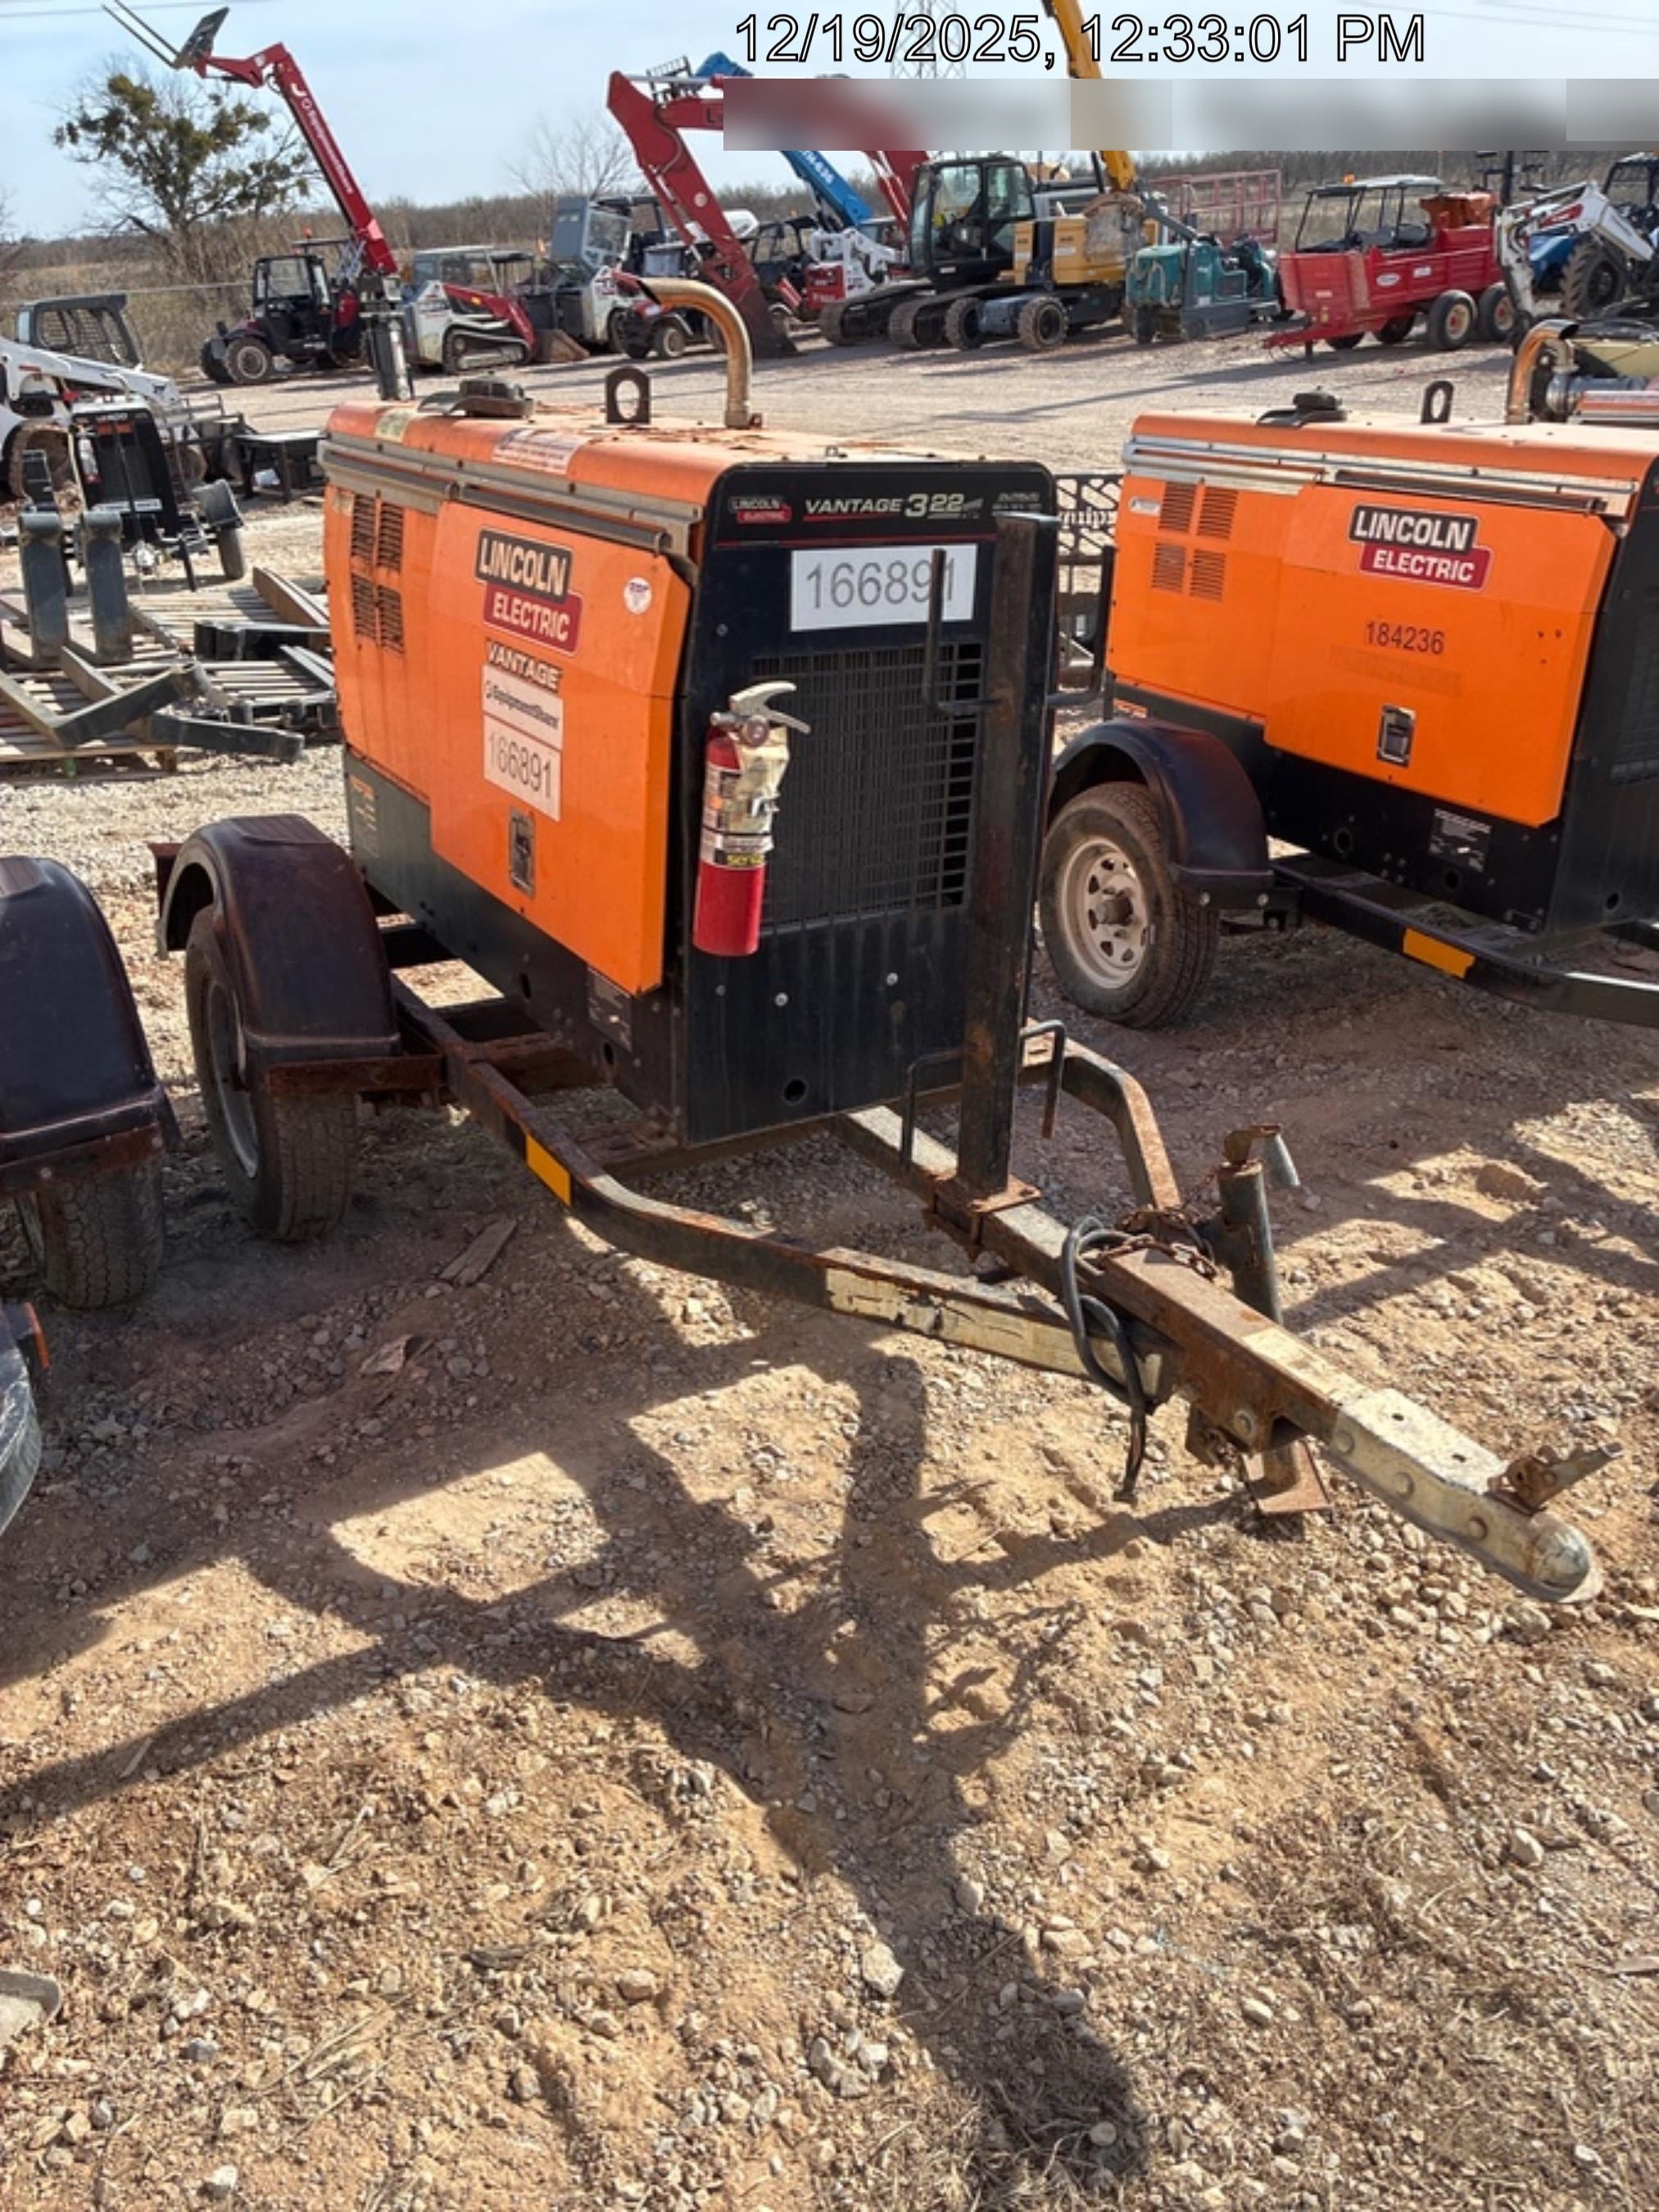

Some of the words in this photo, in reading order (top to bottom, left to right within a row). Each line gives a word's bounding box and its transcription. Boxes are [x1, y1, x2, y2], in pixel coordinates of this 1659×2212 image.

[805, 497, 904, 514] VANTAGE
[904, 492, 965, 517] 322
[1354, 510, 1471, 551] LINCOLN
[478, 537, 567, 596] LINCOLN
[806, 558, 956, 609] 166891
[1373, 550, 1475, 582] ELECTRIC
[493, 592, 571, 641] ELECTRIC
[1367, 621, 1446, 655] 184236
[486, 638, 563, 691] VANTAGE
[488, 732, 551, 800] 166891
